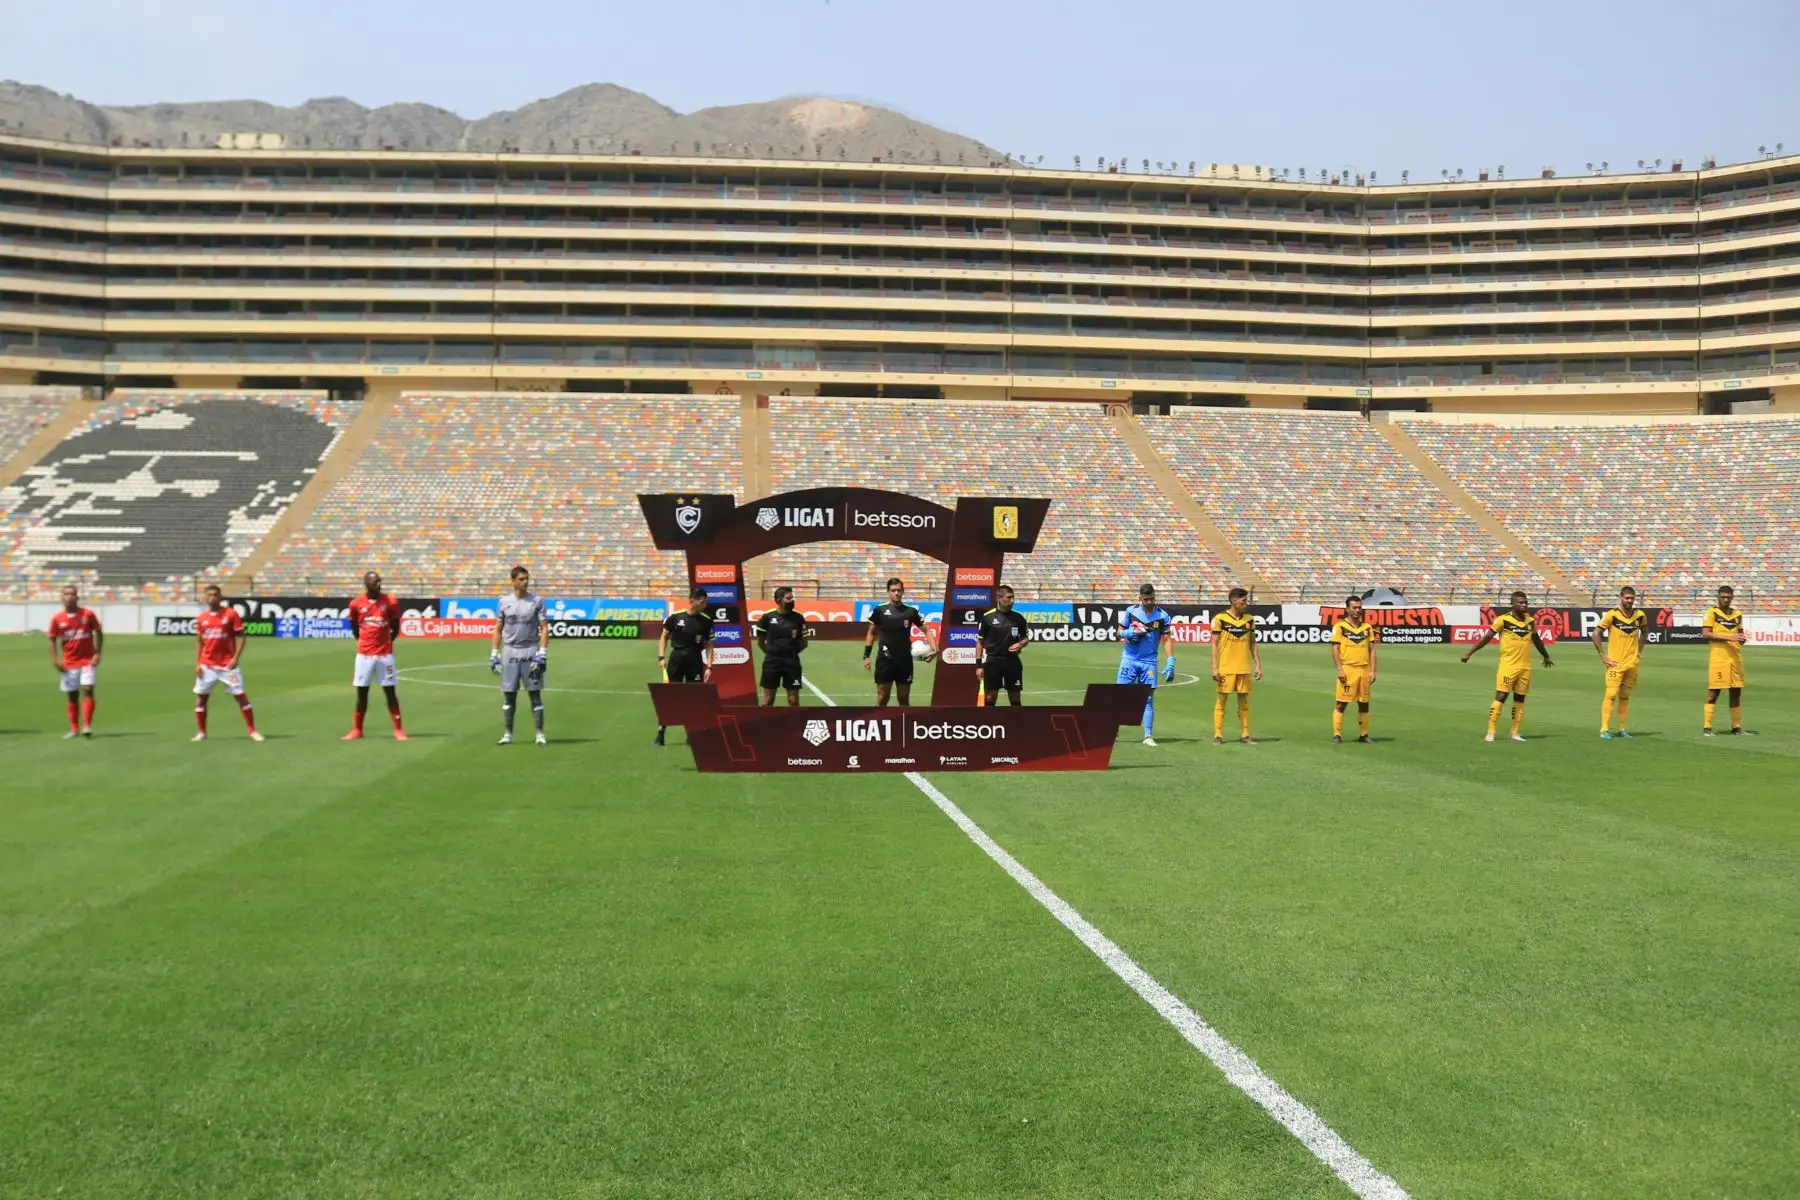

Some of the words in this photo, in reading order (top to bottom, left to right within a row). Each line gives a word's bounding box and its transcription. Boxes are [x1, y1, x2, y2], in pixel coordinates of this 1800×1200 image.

[854, 509, 936, 528] betsson
[697, 570, 734, 578] betsson
[956, 573, 992, 581] betsson
[424, 623, 449, 636] Caja
[454, 622, 496, 635] Huanc
[1027, 624, 1117, 641] oradoBet
[1255, 626, 1332, 643] oradoBe
[1382, 627, 1431, 635] Co-creamos
[1433, 627, 1443, 635] tu
[1382, 635, 1413, 643] espacio
[1415, 635, 1443, 643] seguro
[913, 721, 1006, 740] betsson
[787, 758, 822, 766] betsson
